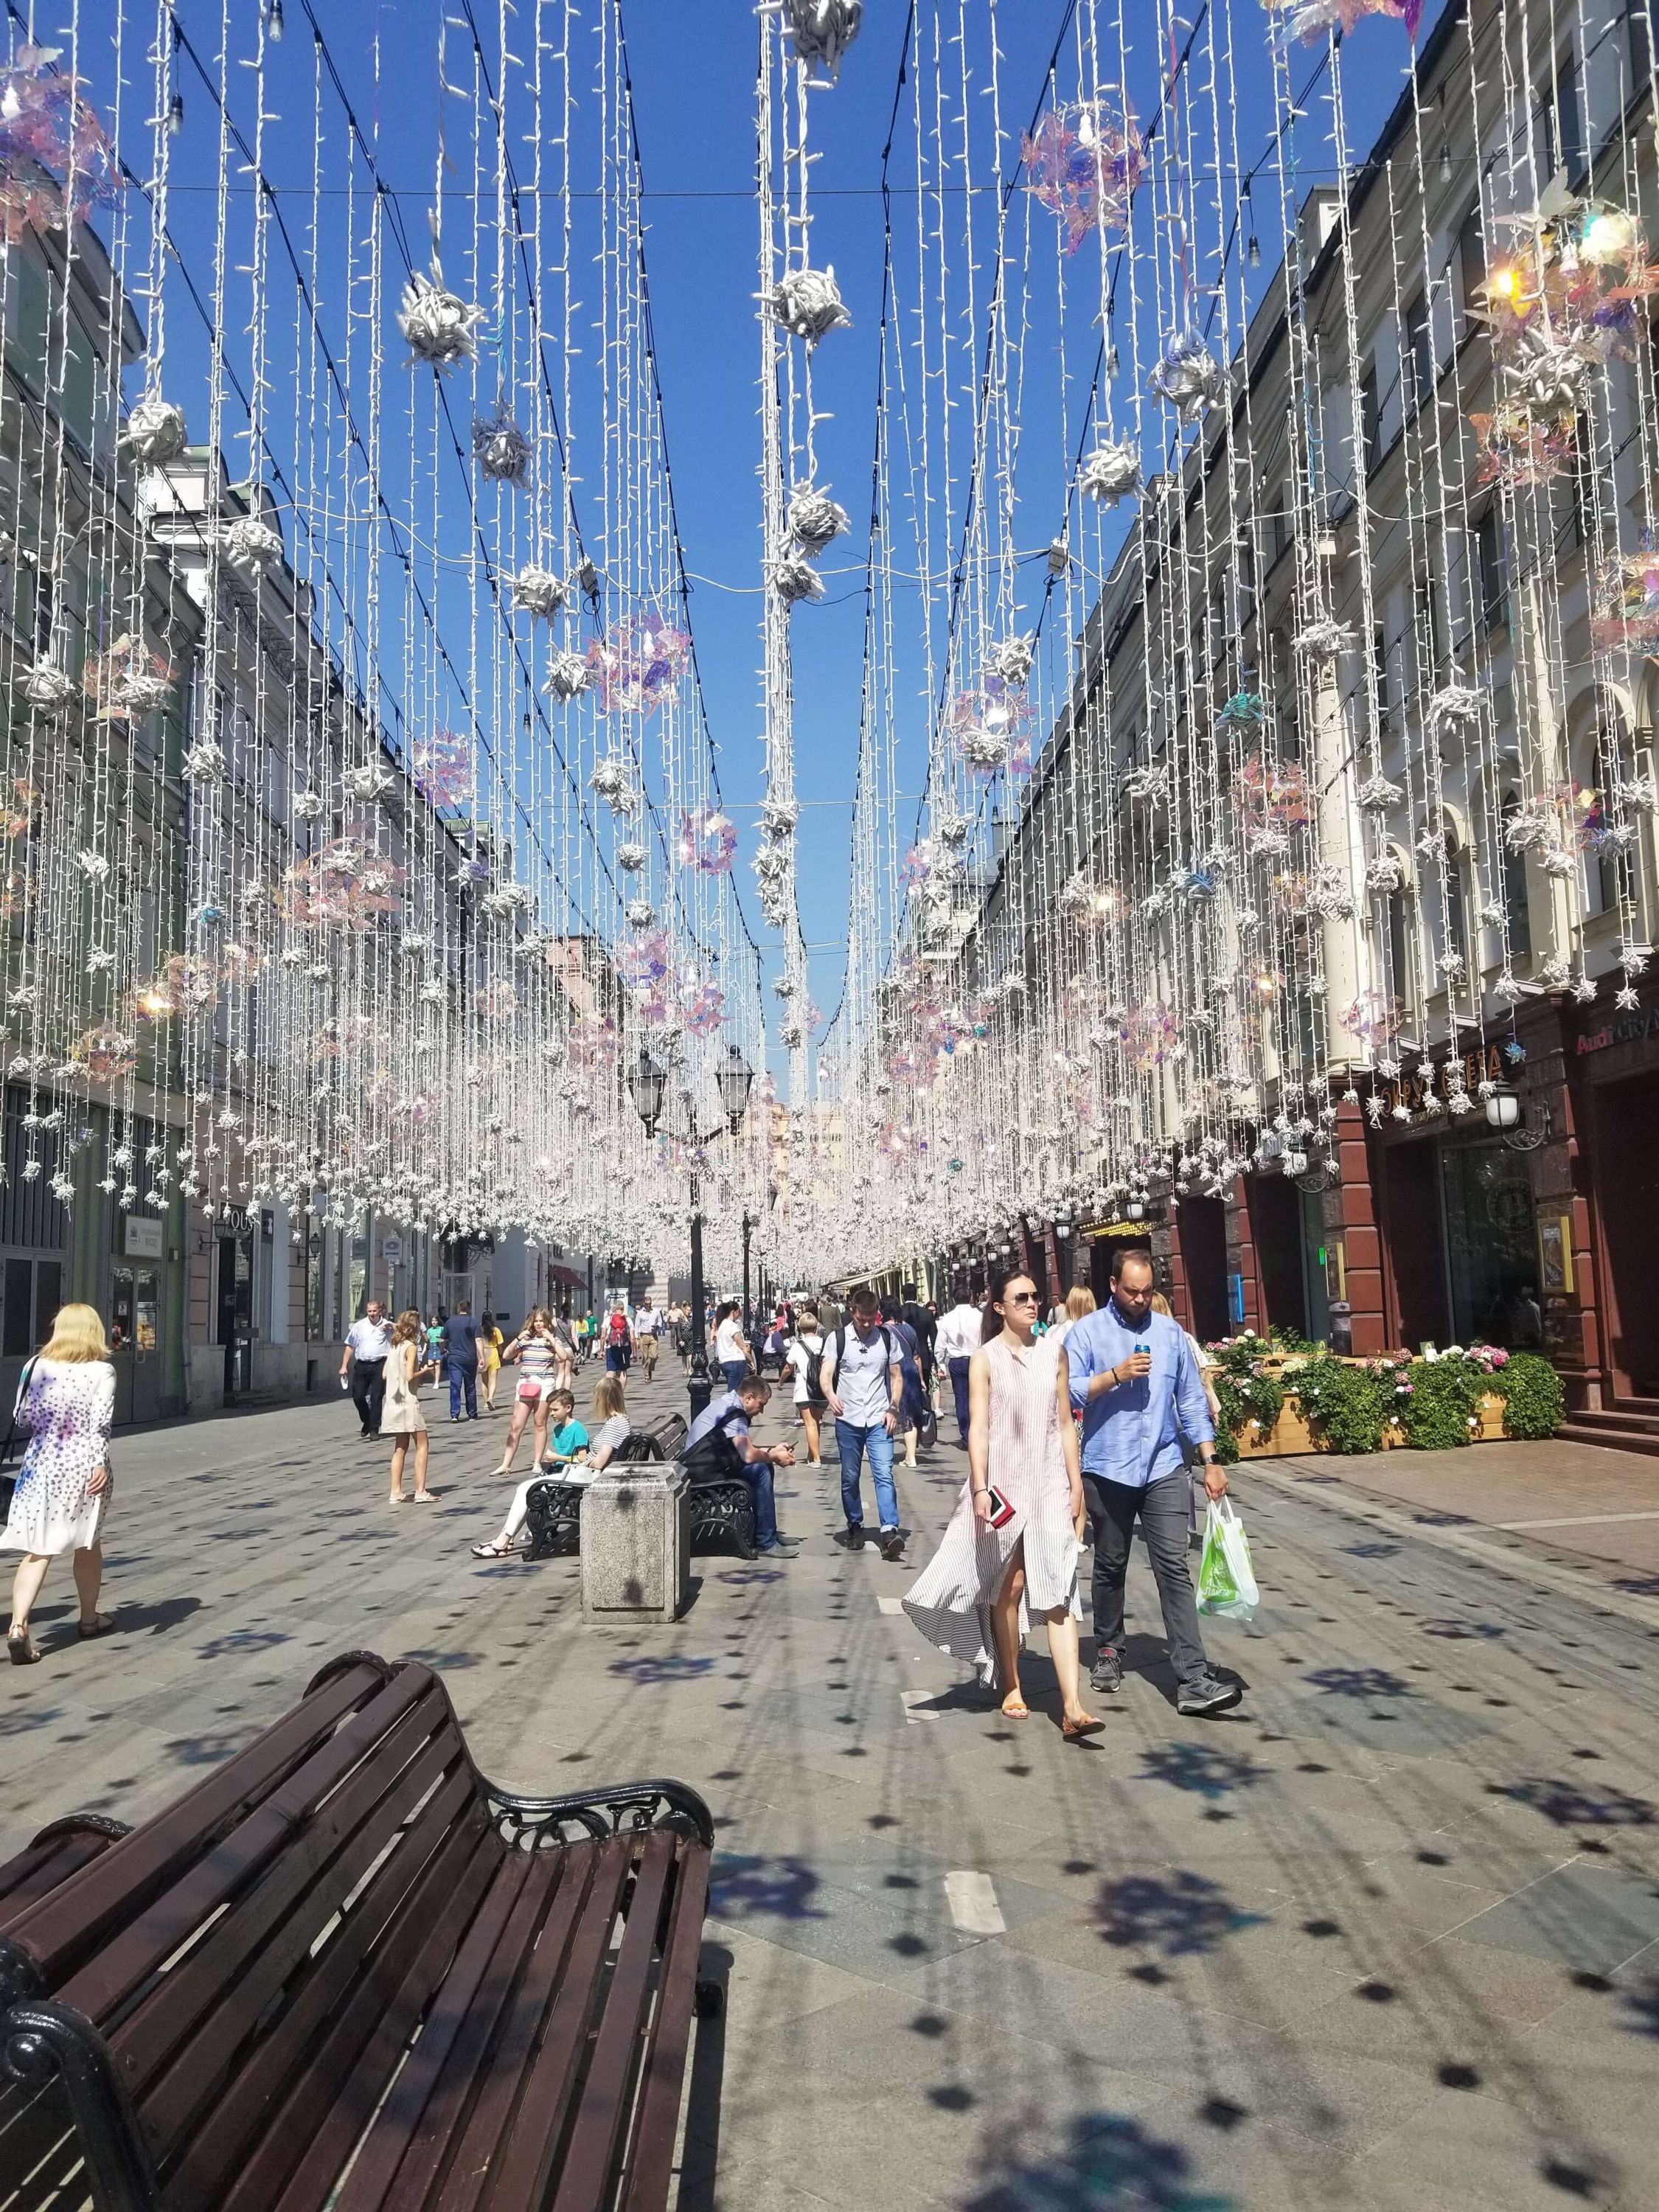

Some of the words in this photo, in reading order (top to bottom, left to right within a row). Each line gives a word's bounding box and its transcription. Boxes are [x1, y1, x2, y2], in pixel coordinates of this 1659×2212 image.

[1576, 1025, 1614, 1055] Audi
[1376, 1075, 1427, 1119] ОКРУ
[1441, 1045, 1503, 1097] СЕТА
[229, 1210, 254, 1231] OUS
